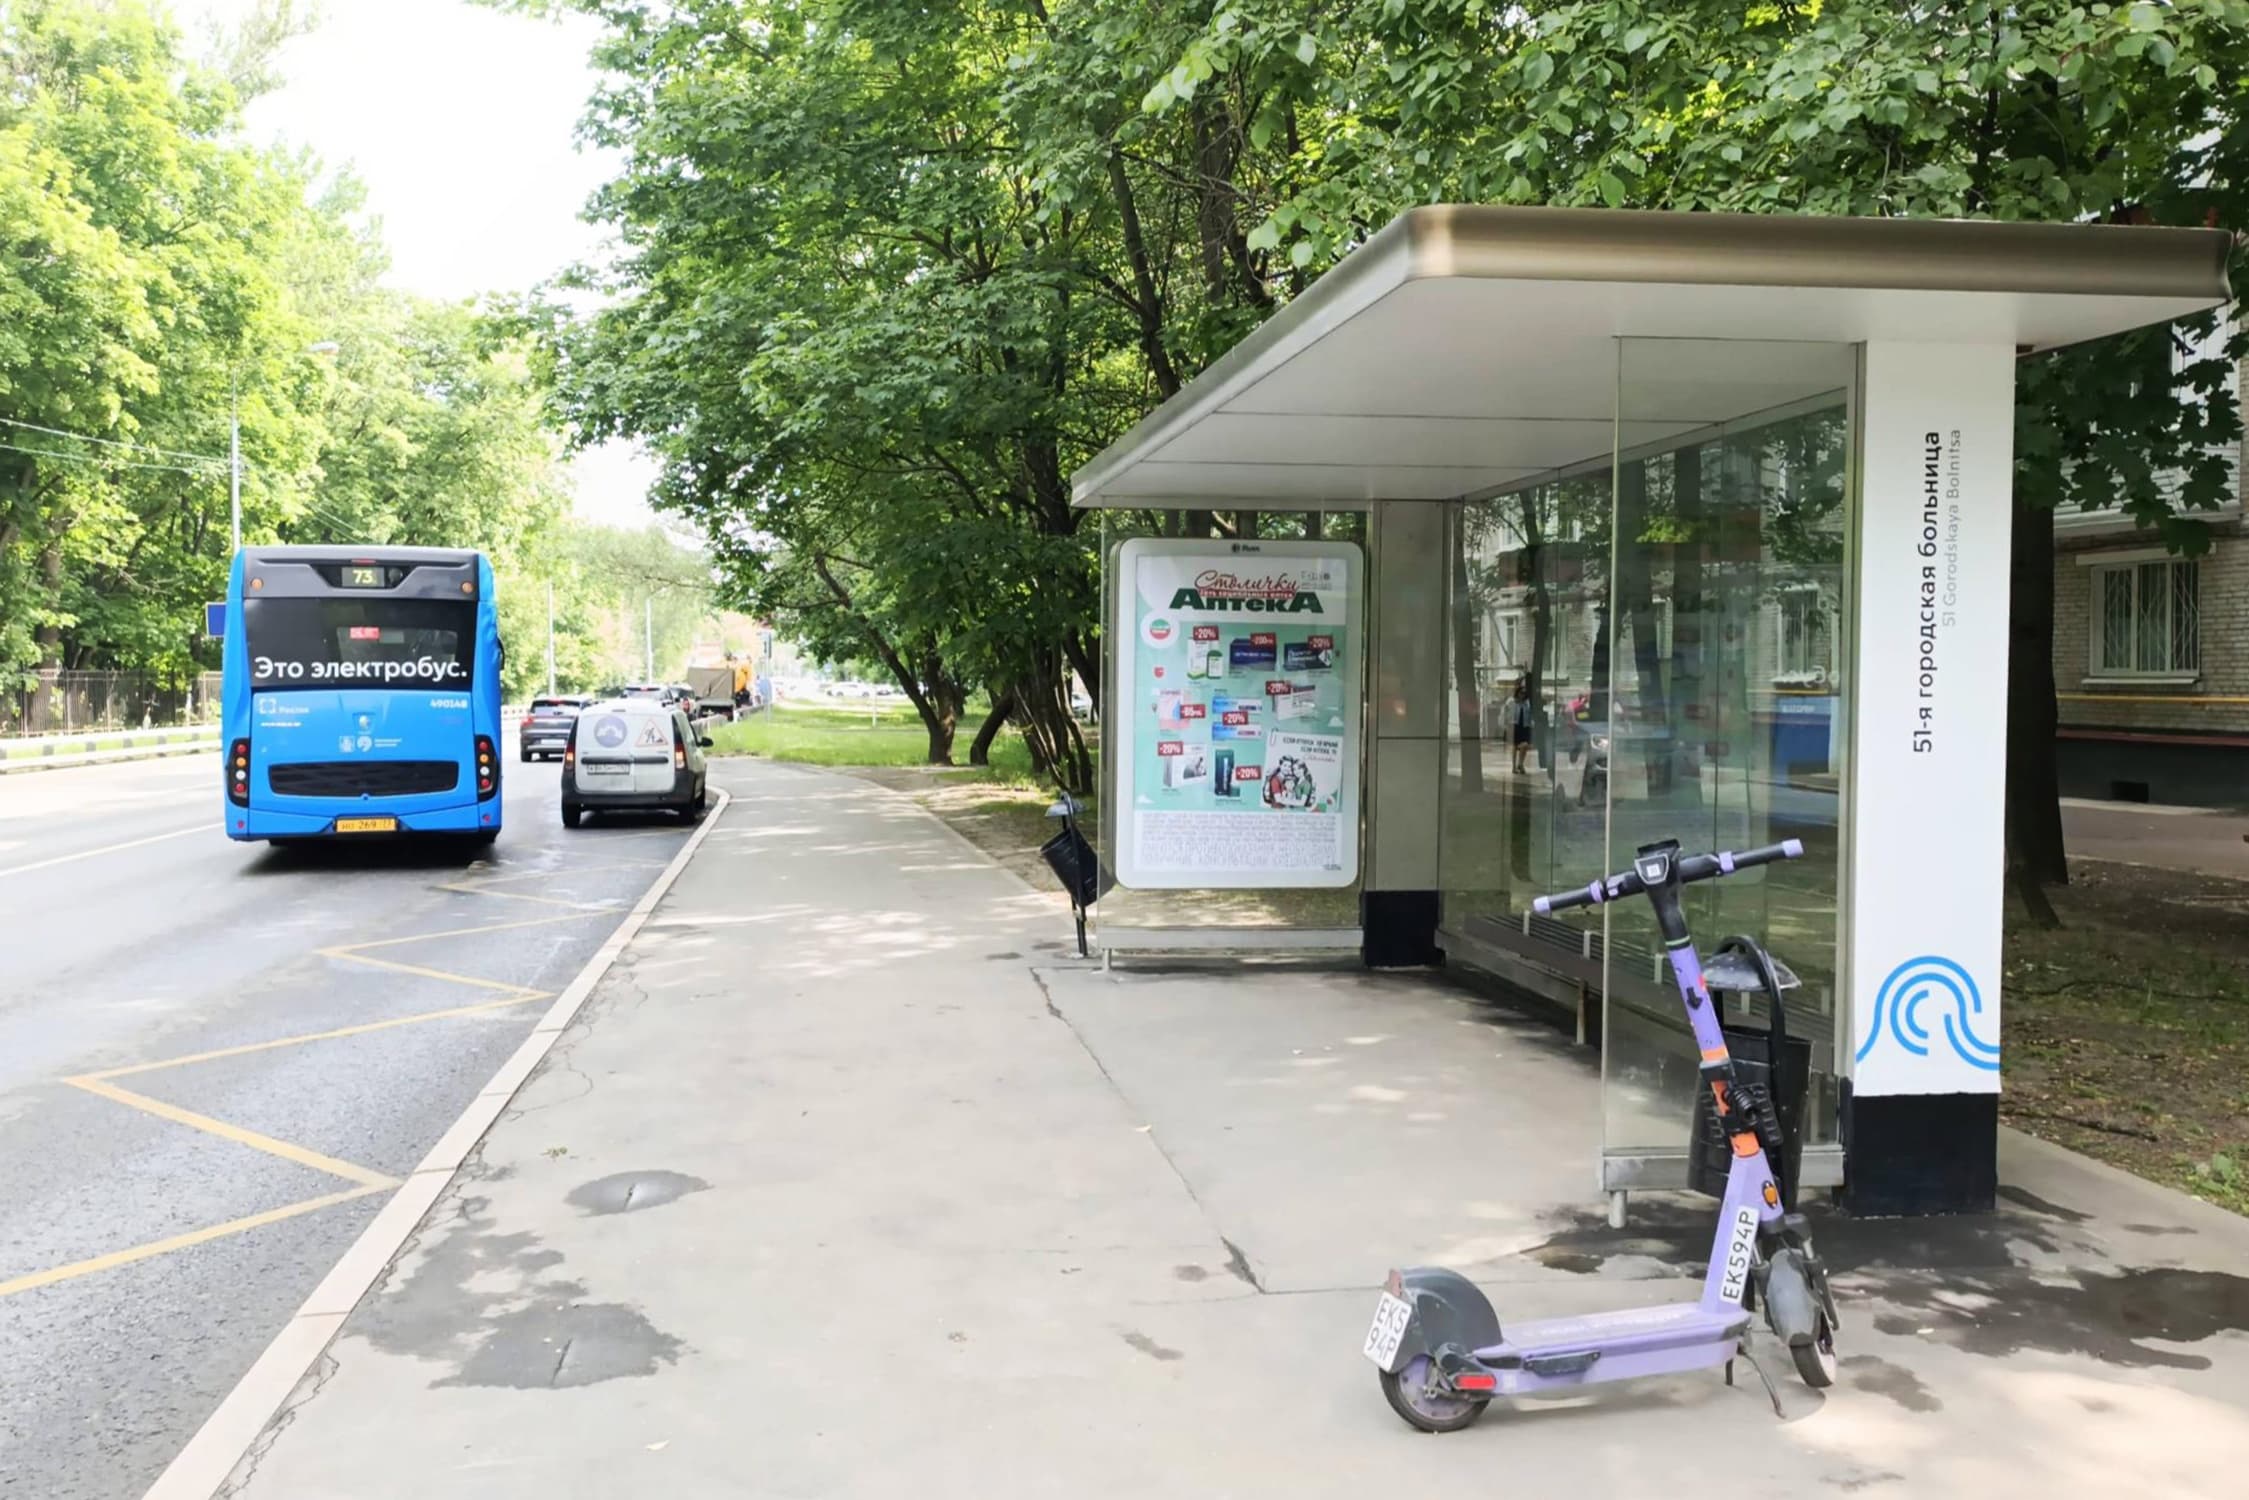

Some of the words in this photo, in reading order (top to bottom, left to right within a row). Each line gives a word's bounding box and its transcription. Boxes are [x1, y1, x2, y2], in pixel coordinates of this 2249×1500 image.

[1946, 430, 1961, 498] Bolnitsa
[1918, 432, 1942, 557] больница
[1942, 504, 1962, 606] Gorodskaya
[352, 569, 373, 585] 73
[1194, 570, 1299, 590] Столички
[1942, 611, 1956, 627] 51
[1195, 628, 1216, 639] -20%
[1918, 565, 1938, 698] городская
[254, 656, 304, 679] Это
[311, 655, 467, 682] электробус.
[1224, 713, 1245, 723] -20%
[1913, 706, 1933, 753] 51-я
[1160, 744, 1181, 754] -20%
[1237, 768, 1258, 778] -20%
